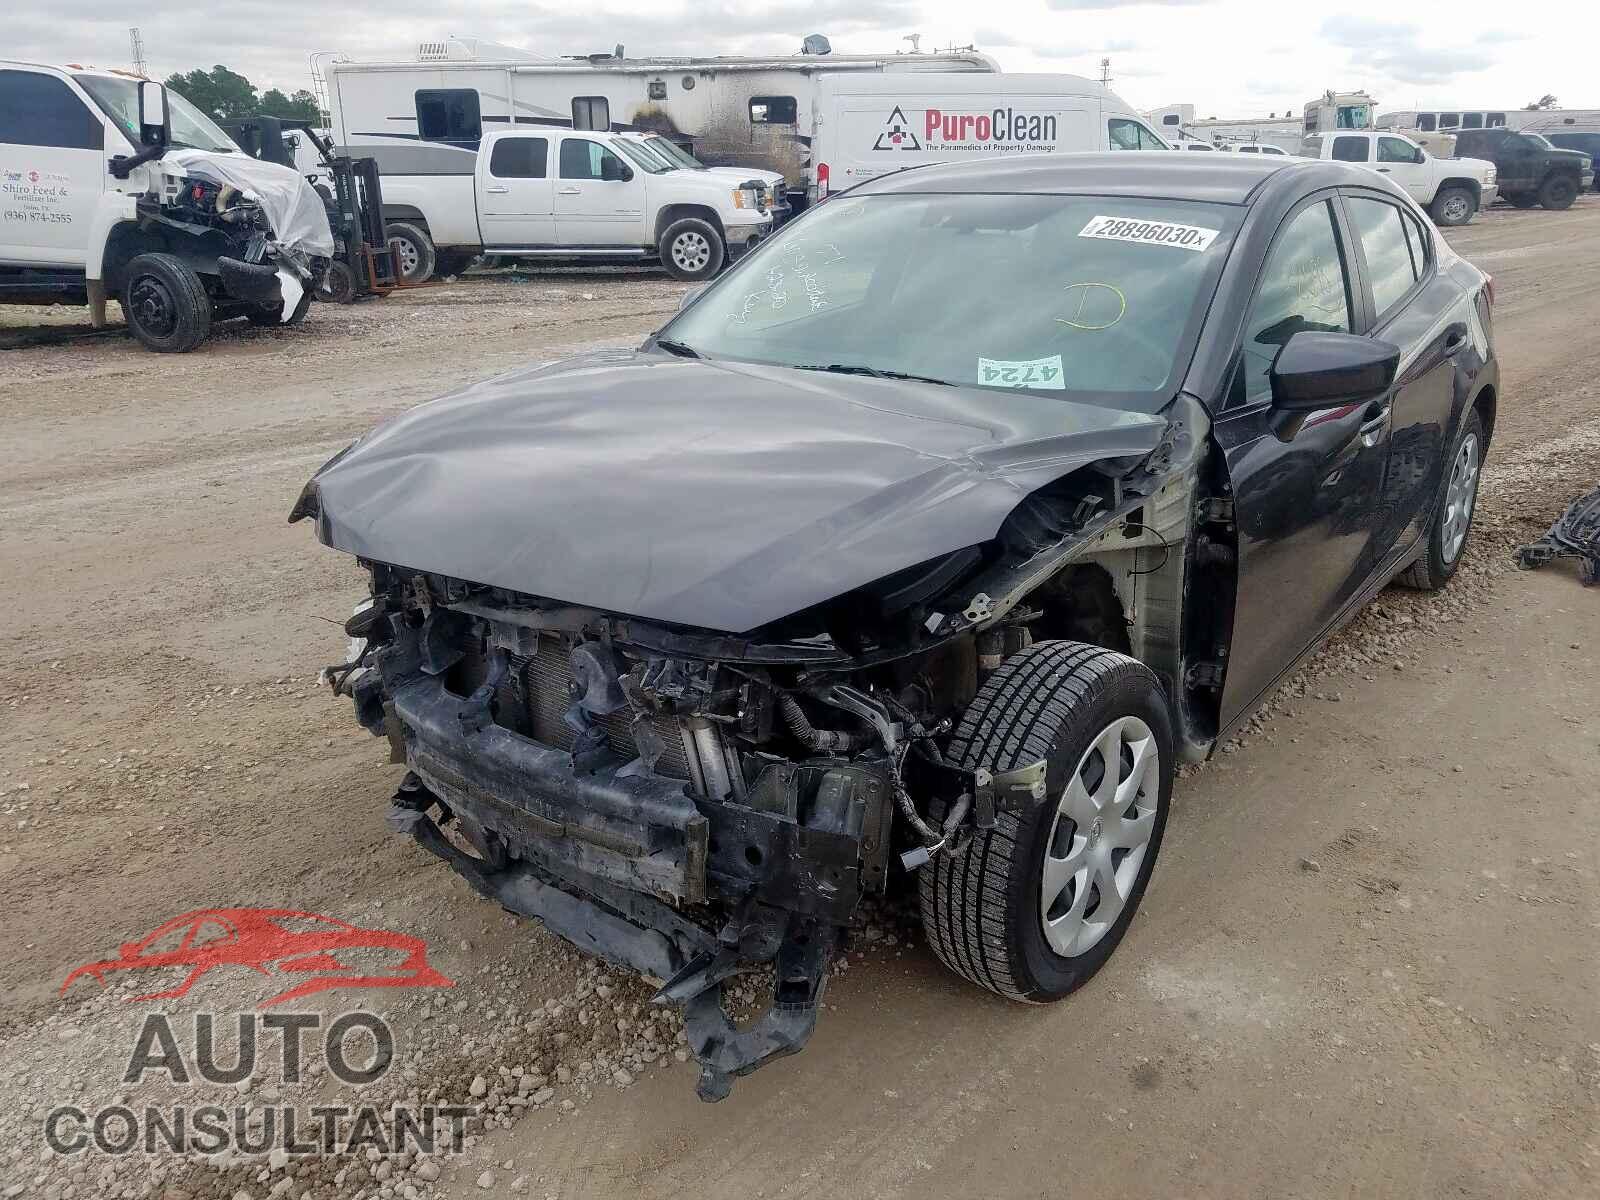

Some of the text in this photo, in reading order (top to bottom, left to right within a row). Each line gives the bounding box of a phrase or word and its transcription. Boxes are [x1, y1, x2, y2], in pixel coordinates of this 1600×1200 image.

[925, 108, 1057, 141] PuroClean
[993, 144, 1025, 153] Property
[1026, 144, 1056, 153] Damage
[2, 183, 30, 194] Shiro
[33, 185, 56, 196] Feed
[4, 210, 72, 224] (936) 874-2555
[983, 365, 1058, 382] 4724
